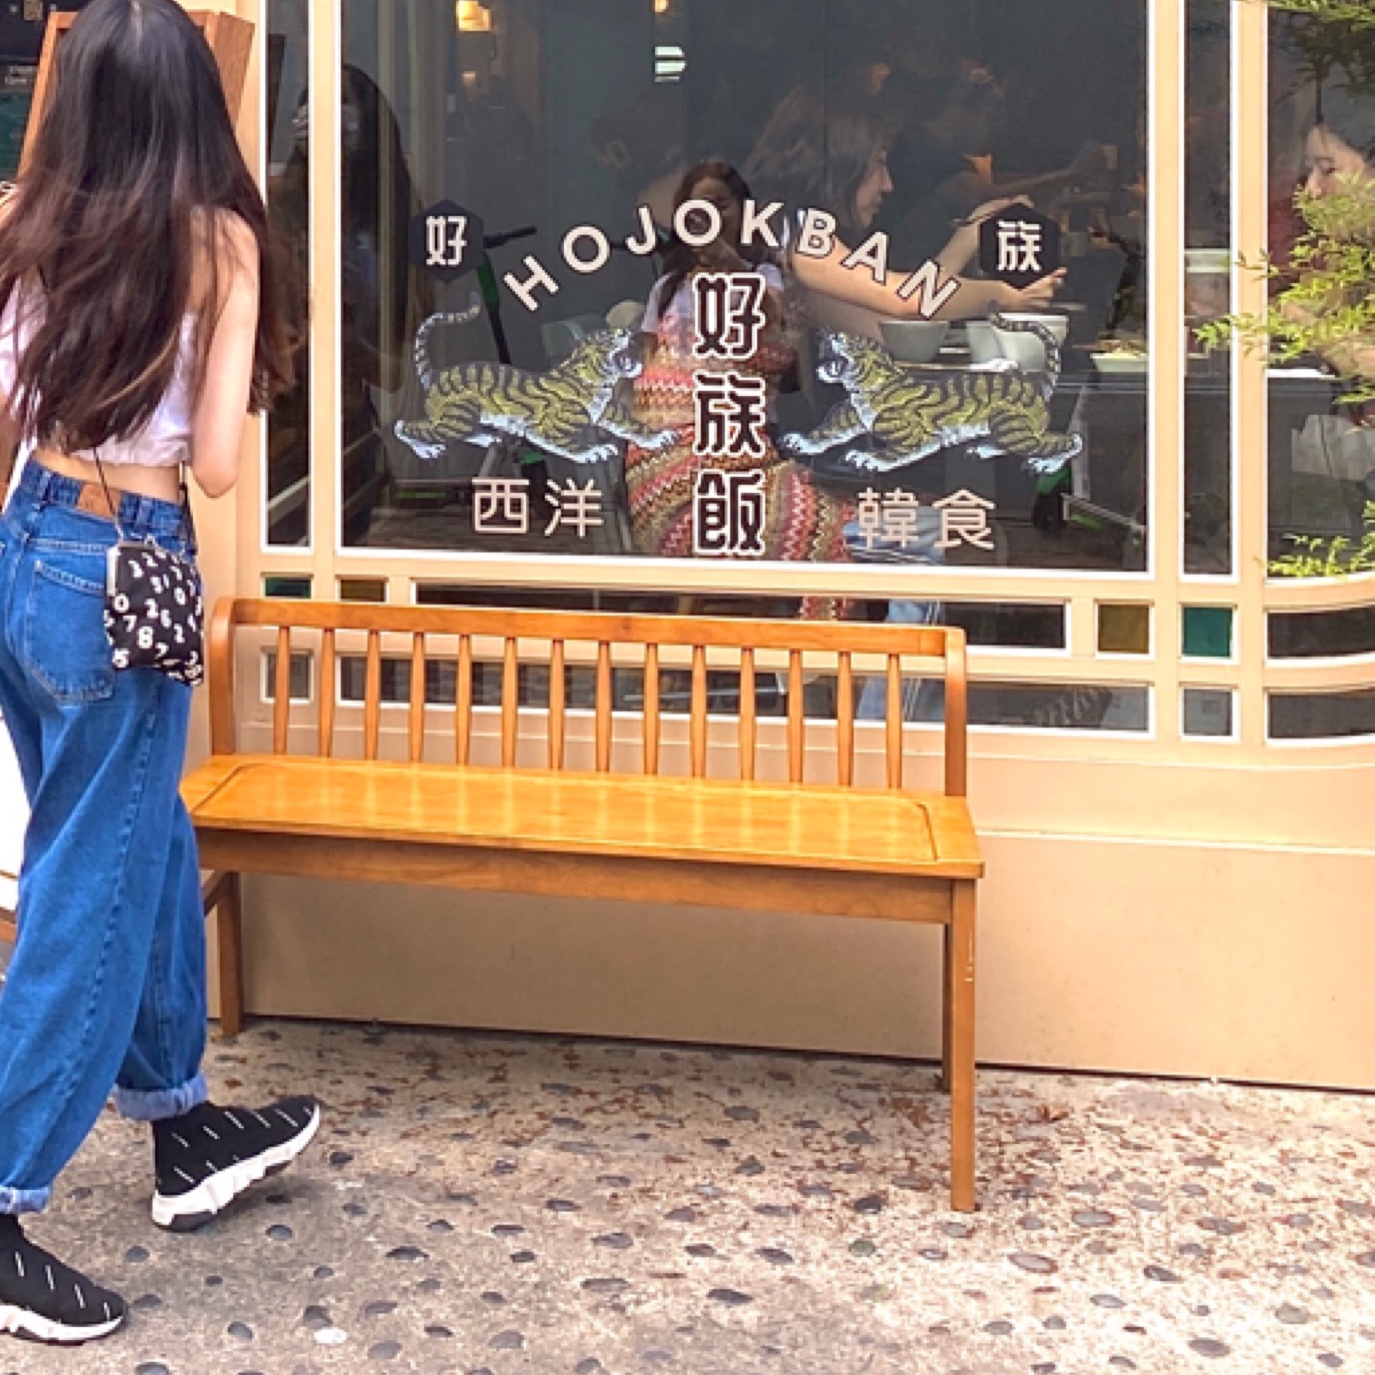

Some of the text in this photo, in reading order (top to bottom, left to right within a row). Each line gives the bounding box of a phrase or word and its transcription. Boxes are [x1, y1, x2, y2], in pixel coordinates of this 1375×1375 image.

[424, 214, 468, 269] 好
[502, 198, 962, 321] HOJOKBAN
[995, 219, 1043, 274] 族
[470, 477, 997, 553] 西洋 韓食
